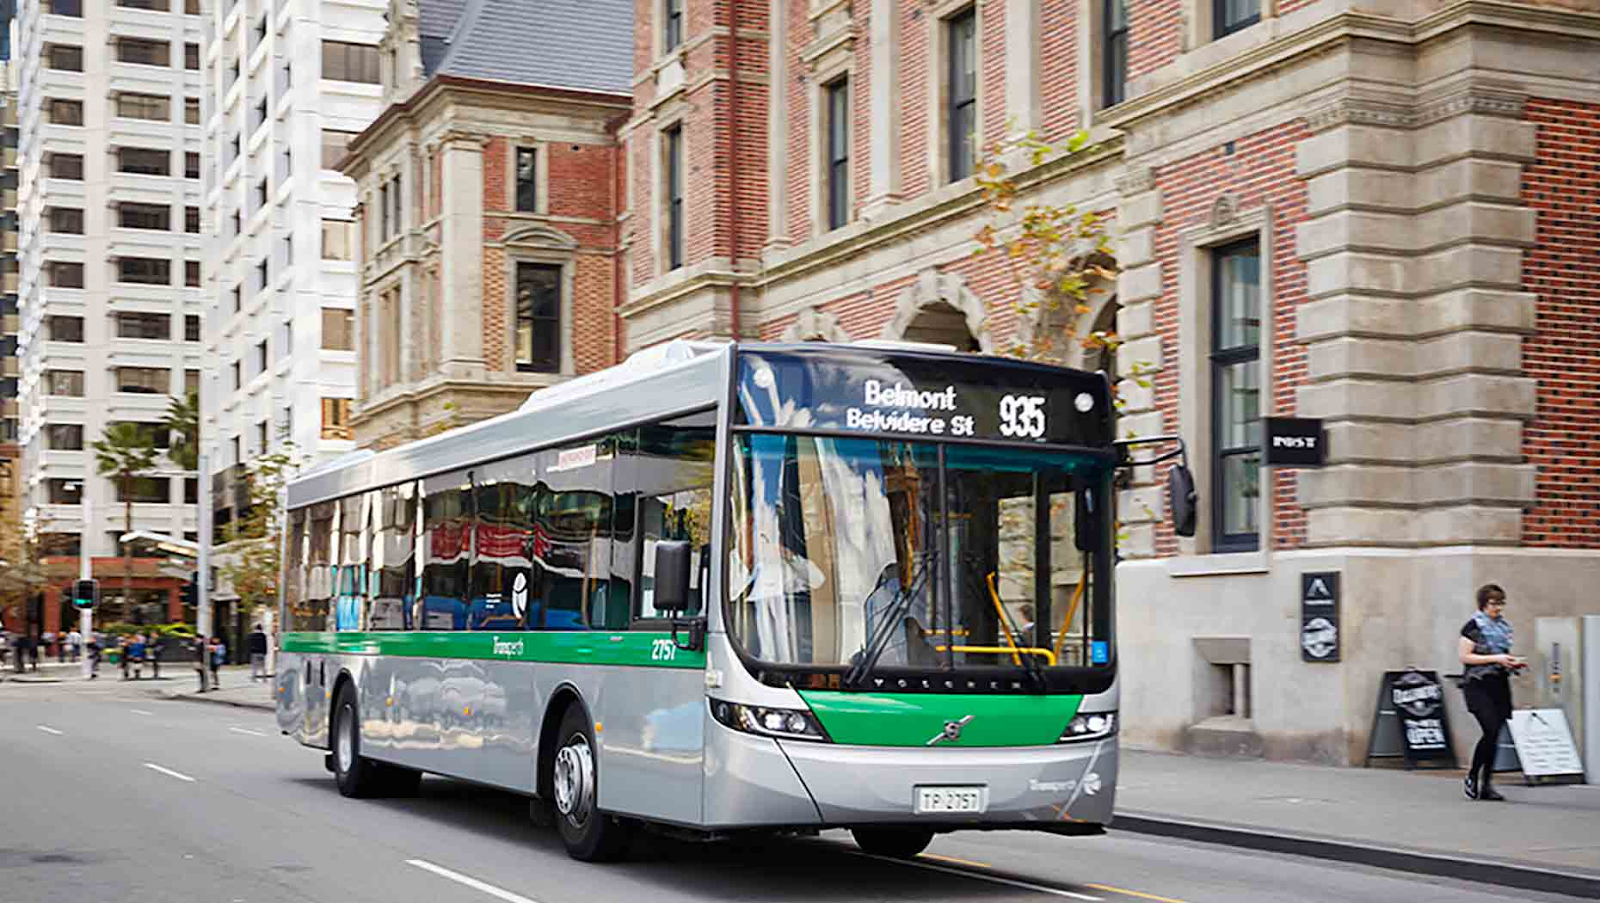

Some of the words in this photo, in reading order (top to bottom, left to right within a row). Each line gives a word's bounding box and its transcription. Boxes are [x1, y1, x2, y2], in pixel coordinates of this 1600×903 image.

[864, 379, 957, 411] Belmont
[846, 407, 946, 434] Belvidere
[950, 415, 975, 436] St
[999, 394, 1046, 438] 935
[651, 639, 677, 661] 2757
[945, 793, 978, 810] 2757
